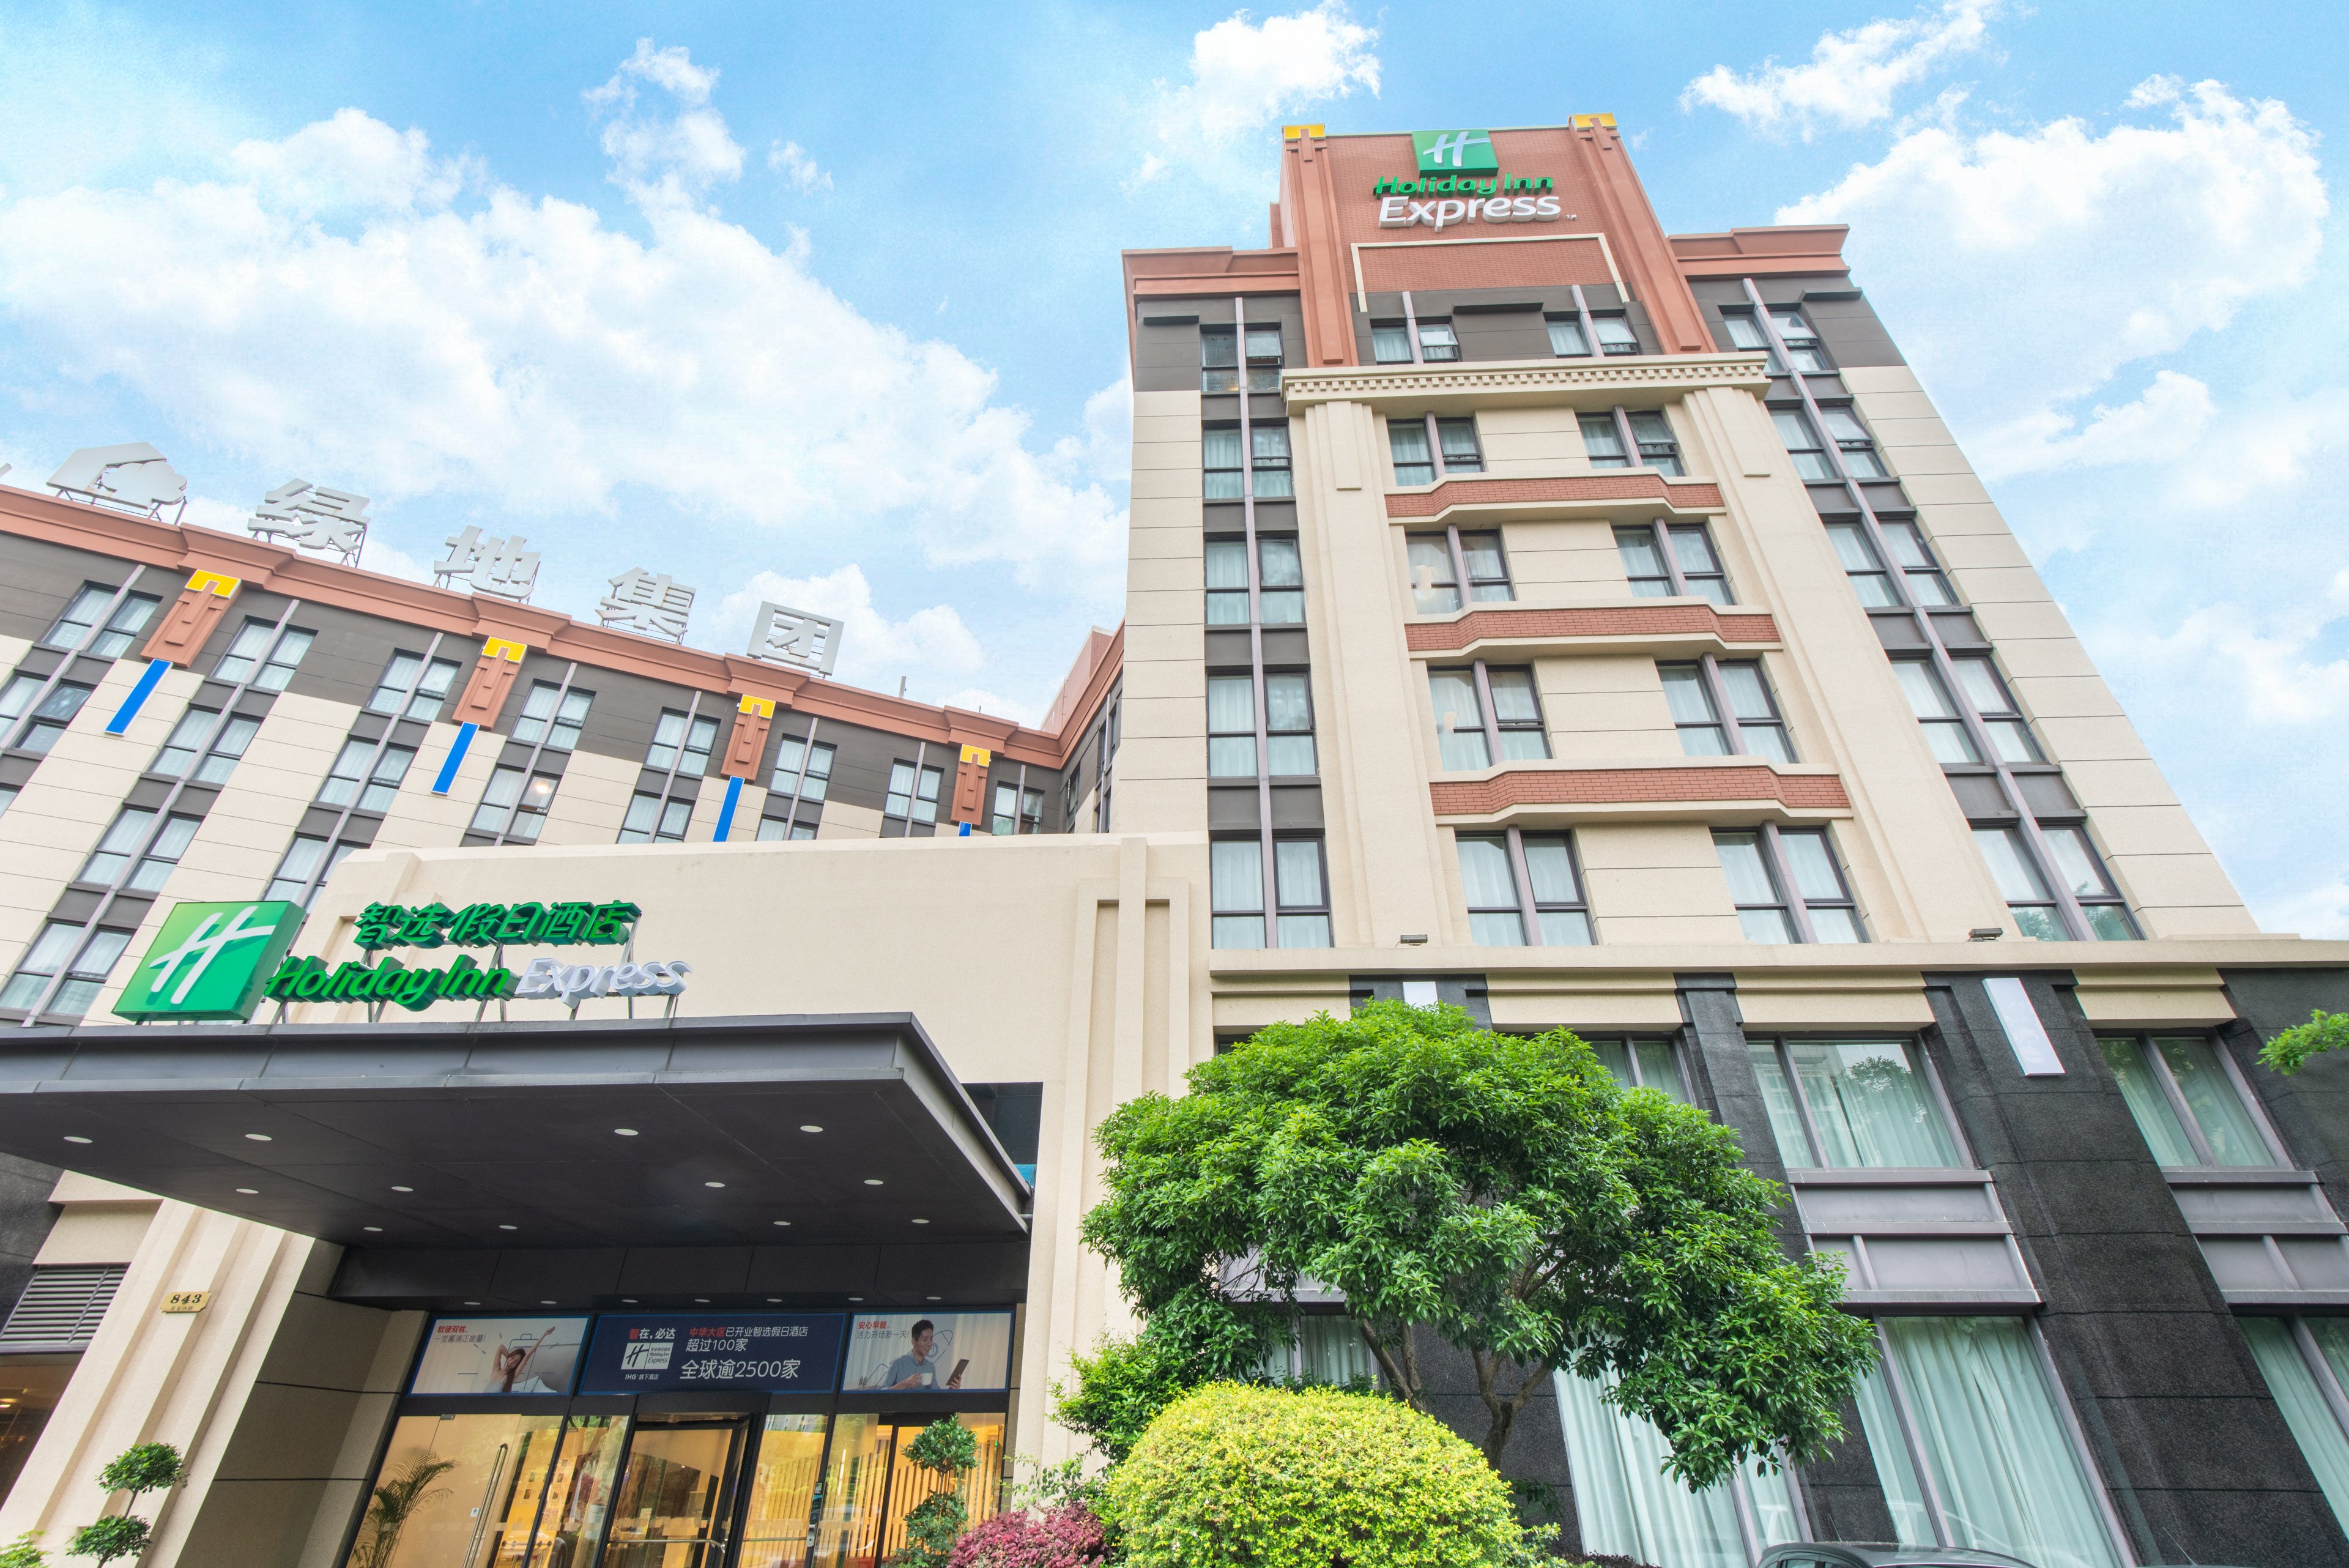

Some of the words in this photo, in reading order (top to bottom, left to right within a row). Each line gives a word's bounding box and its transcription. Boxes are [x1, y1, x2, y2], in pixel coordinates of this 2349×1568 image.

[1373, 174, 1497, 200] Holiday
[1504, 172, 1554, 196] Inn
[1379, 196, 1561, 232] Express
[247, 478, 845, 676] 绿地集团
[354, 900, 642, 950] 智选假日酒店
[264, 955, 447, 1011] Holiday
[437, 954, 518, 1001] Inn
[515, 957, 694, 1009] Express
[170, 1294, 202, 1304] 843
[689, 1326, 809, 1337] 中华大区已开业智选假日酒店
[856, 1330, 909, 1339] 活力开场新一天!
[685, 1338, 748, 1352] 超过100家
[648, 1356, 668, 1365] Express
[680, 1359, 801, 1379] 全球逾2500家
